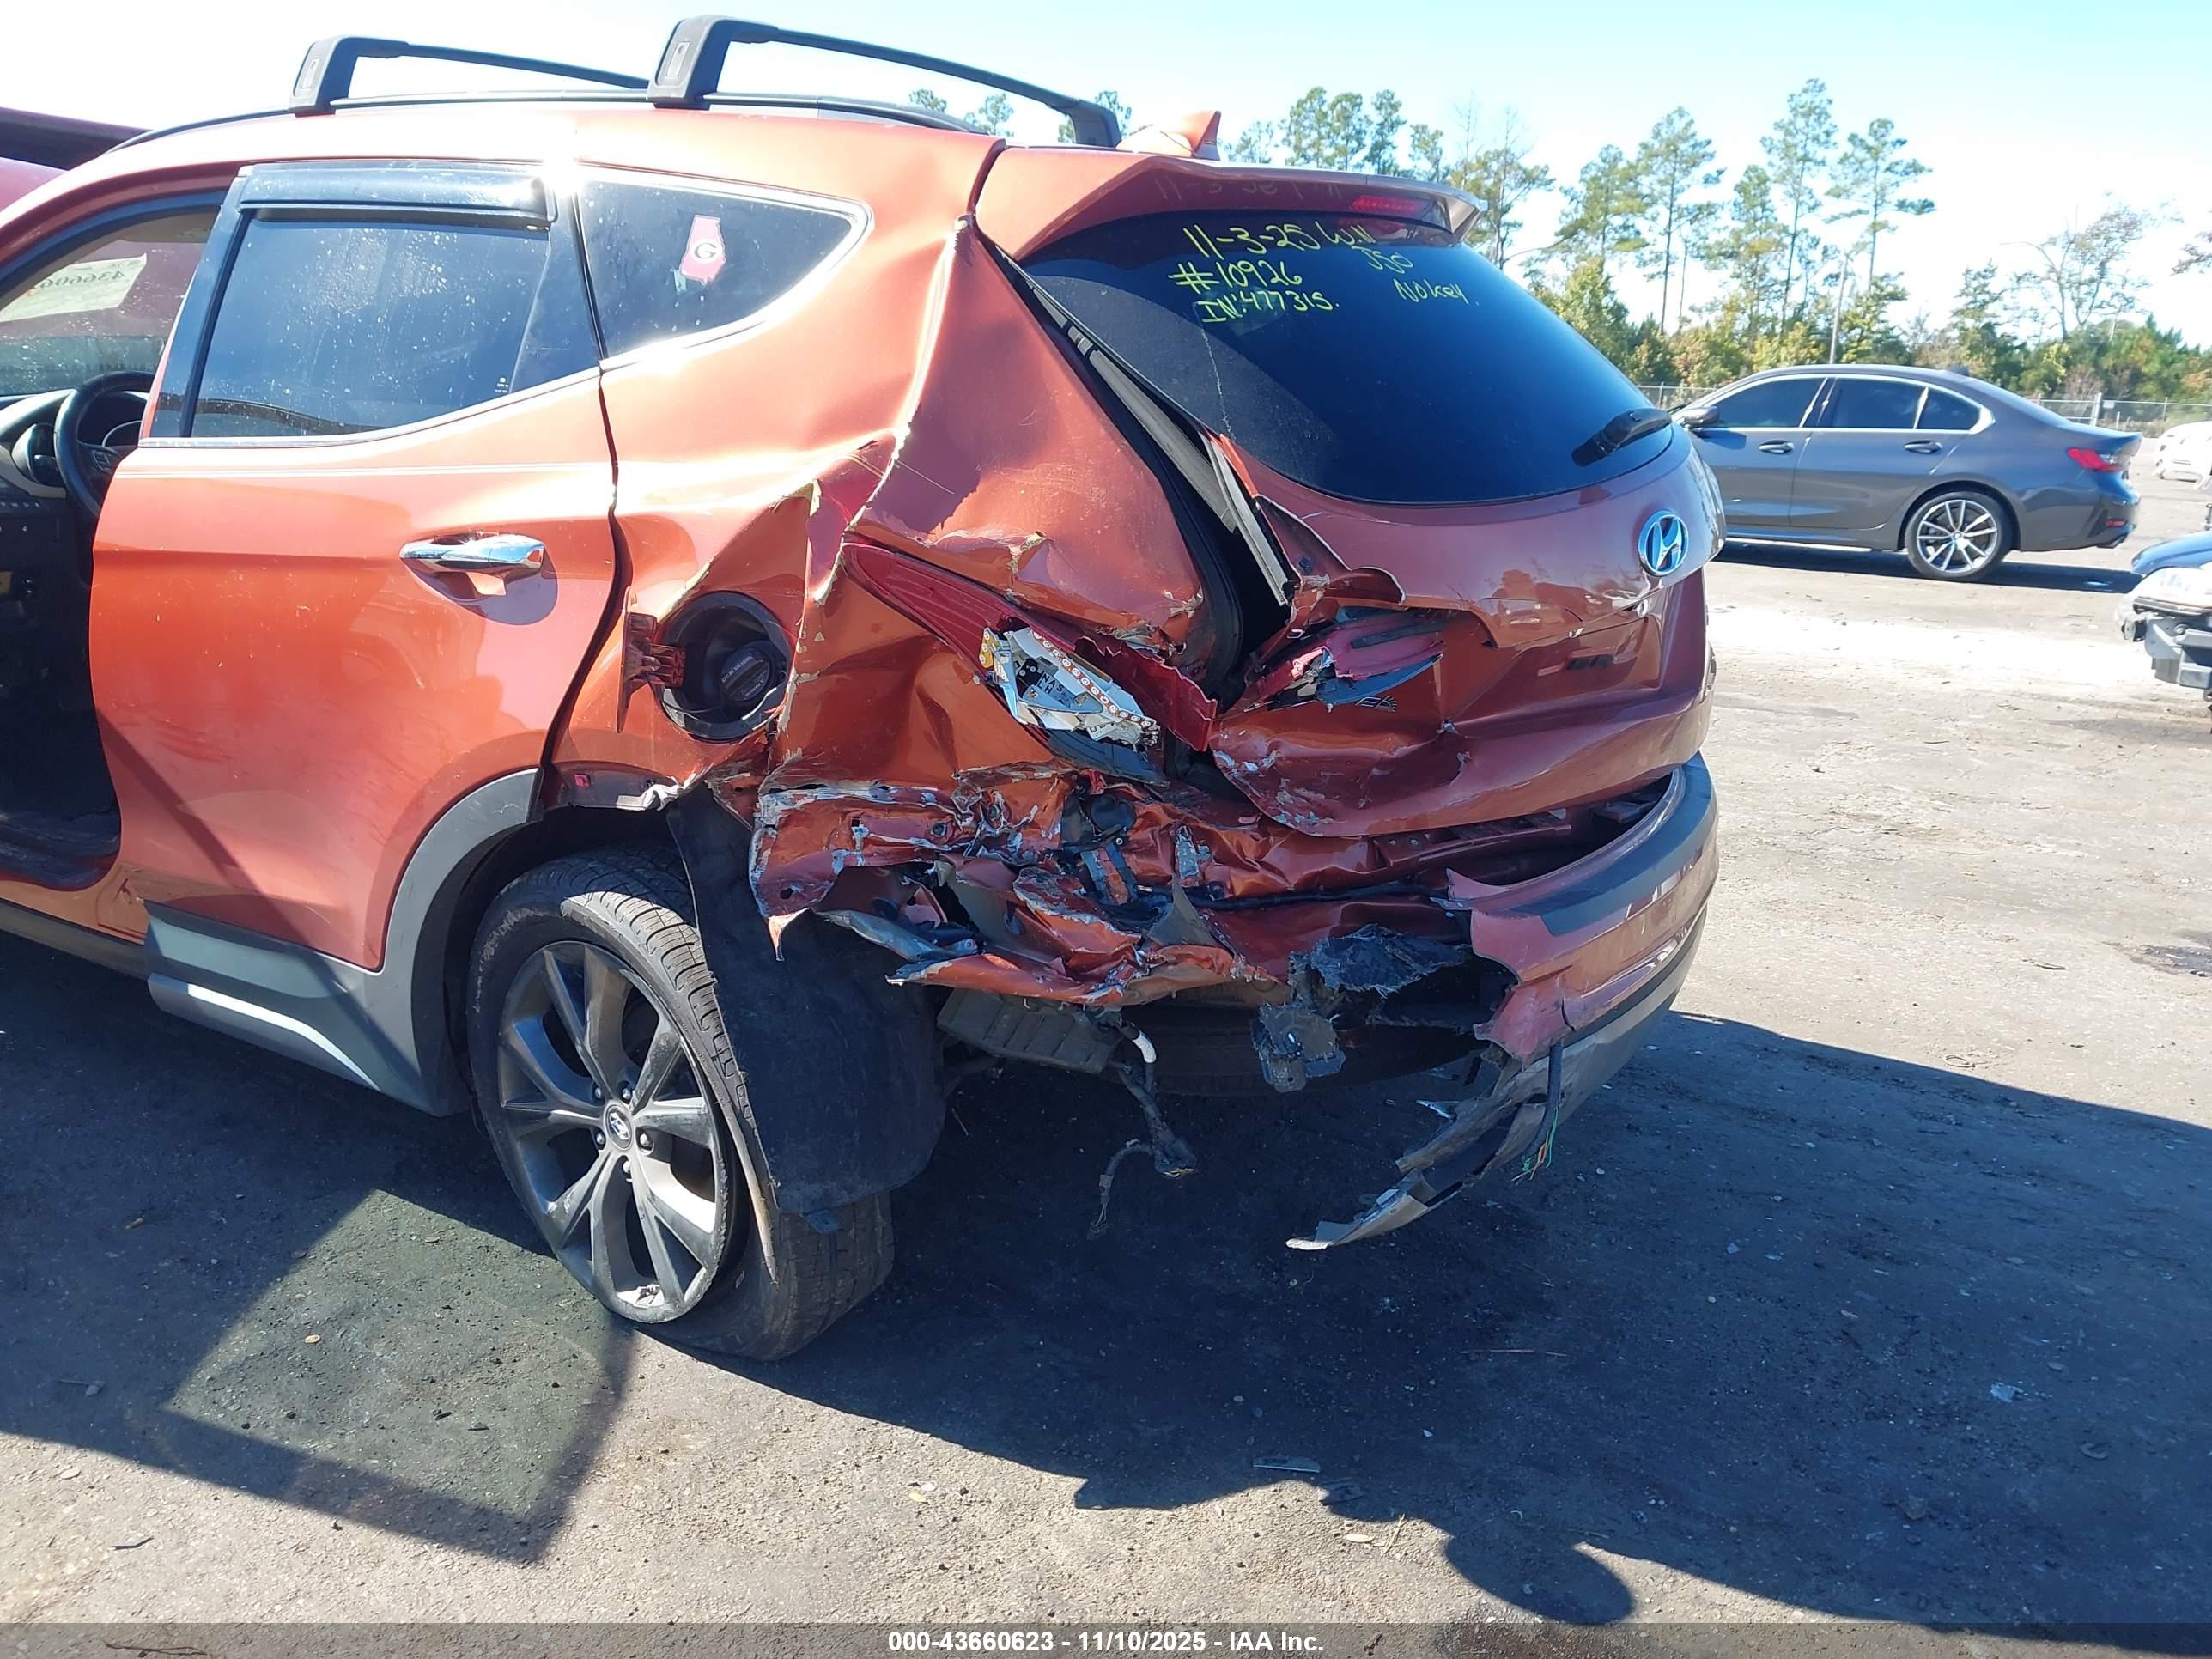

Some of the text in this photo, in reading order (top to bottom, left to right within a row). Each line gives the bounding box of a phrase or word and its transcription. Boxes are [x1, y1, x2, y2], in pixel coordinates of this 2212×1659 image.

[694, 242, 718, 259] G
[1182, 223, 1322, 260] 11-3-25
[1168, 260, 1304, 295] #10926
[1037, 680, 1054, 695] LH
[1041, 672, 1065, 692] NAS
